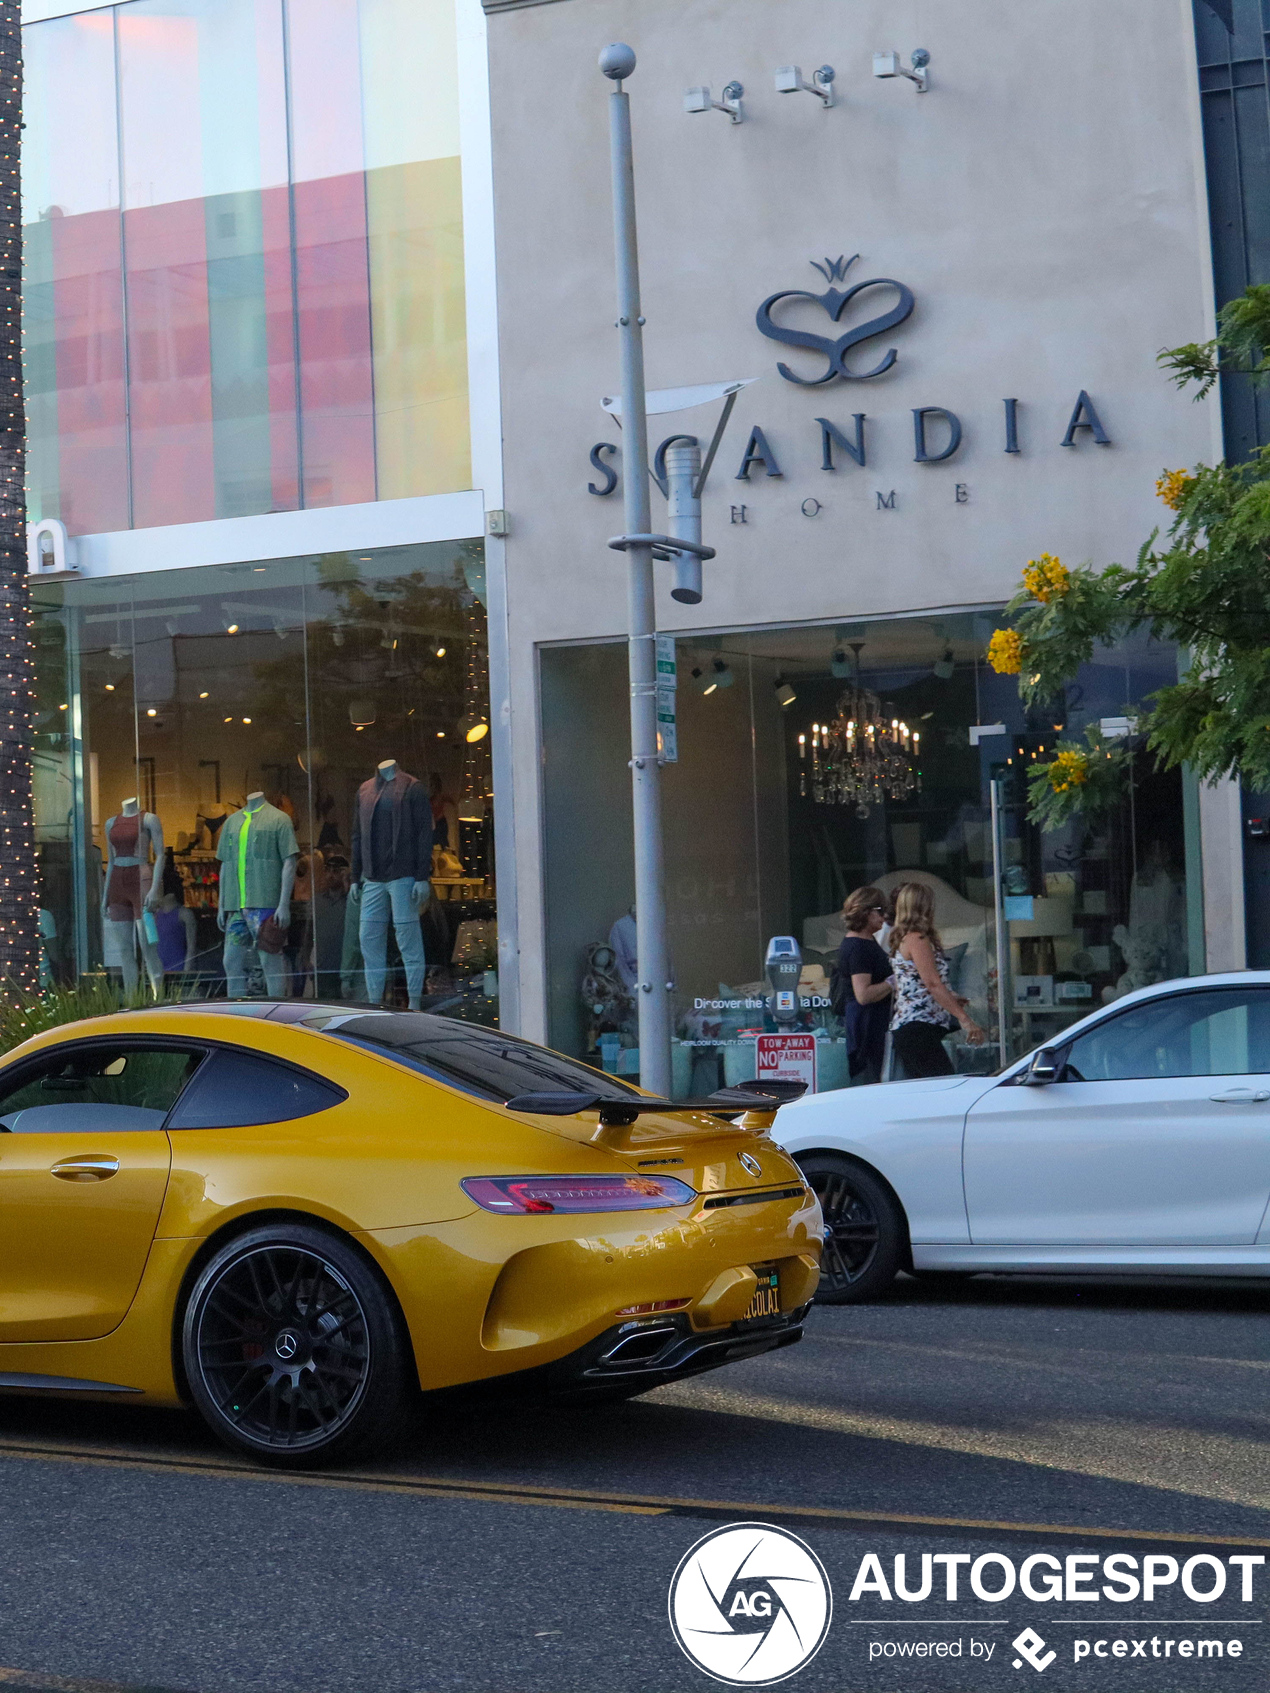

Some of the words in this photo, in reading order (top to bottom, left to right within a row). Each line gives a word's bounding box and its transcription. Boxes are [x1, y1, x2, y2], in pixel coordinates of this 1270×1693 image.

[730, 483, 969, 524] HOME
[780, 964, 797, 973] 322
[744, 998, 763, 1009] the
[763, 1038, 810, 1049] TOW-AWAY
[759, 1050, 777, 1067] NO
[779, 1051, 812, 1061] PARKING
[744, 1287, 780, 1319] COLAI
